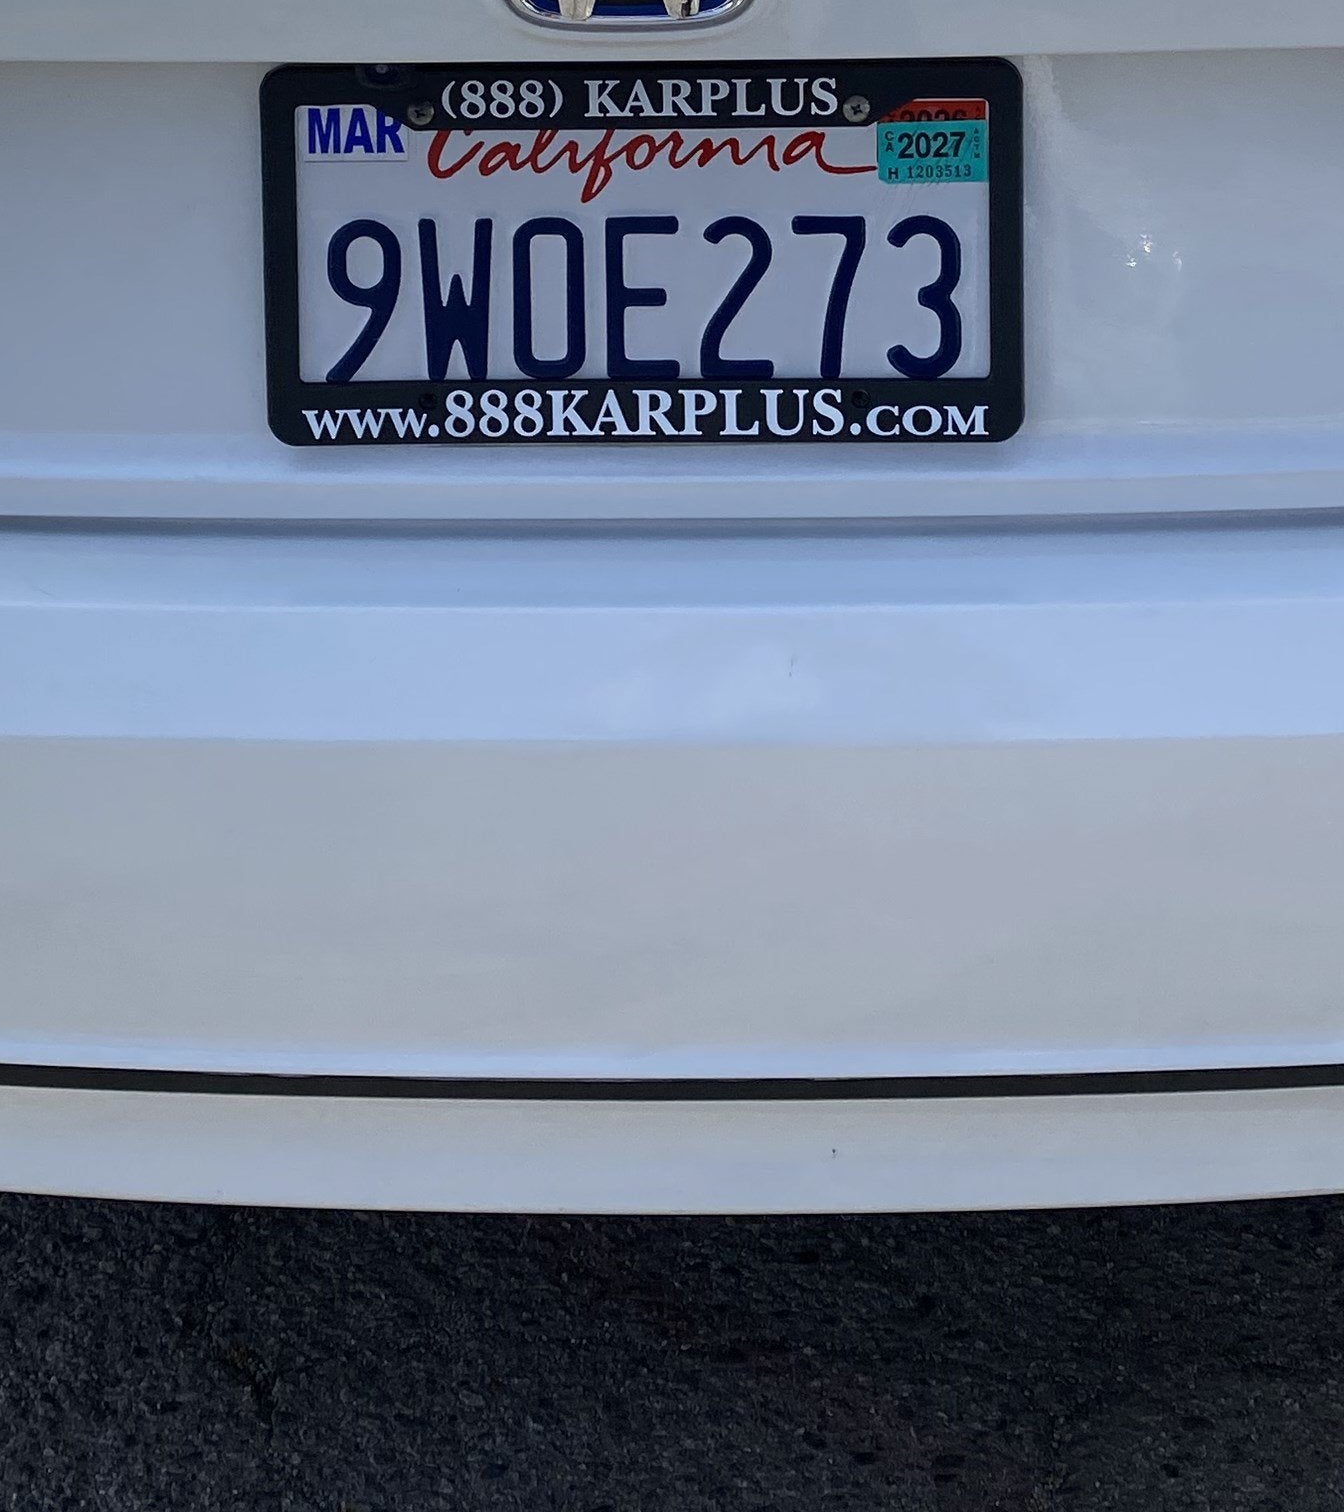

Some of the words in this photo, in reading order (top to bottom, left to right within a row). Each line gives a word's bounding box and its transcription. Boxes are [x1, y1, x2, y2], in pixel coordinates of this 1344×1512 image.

[441, 79, 564, 120] (888)
[583, 76, 838, 118] KARPLUS
[307, 107, 406, 155] MAR
[897, 131, 966, 159] 2027
[427, 128, 878, 204] California
[887, 167, 899, 180] H
